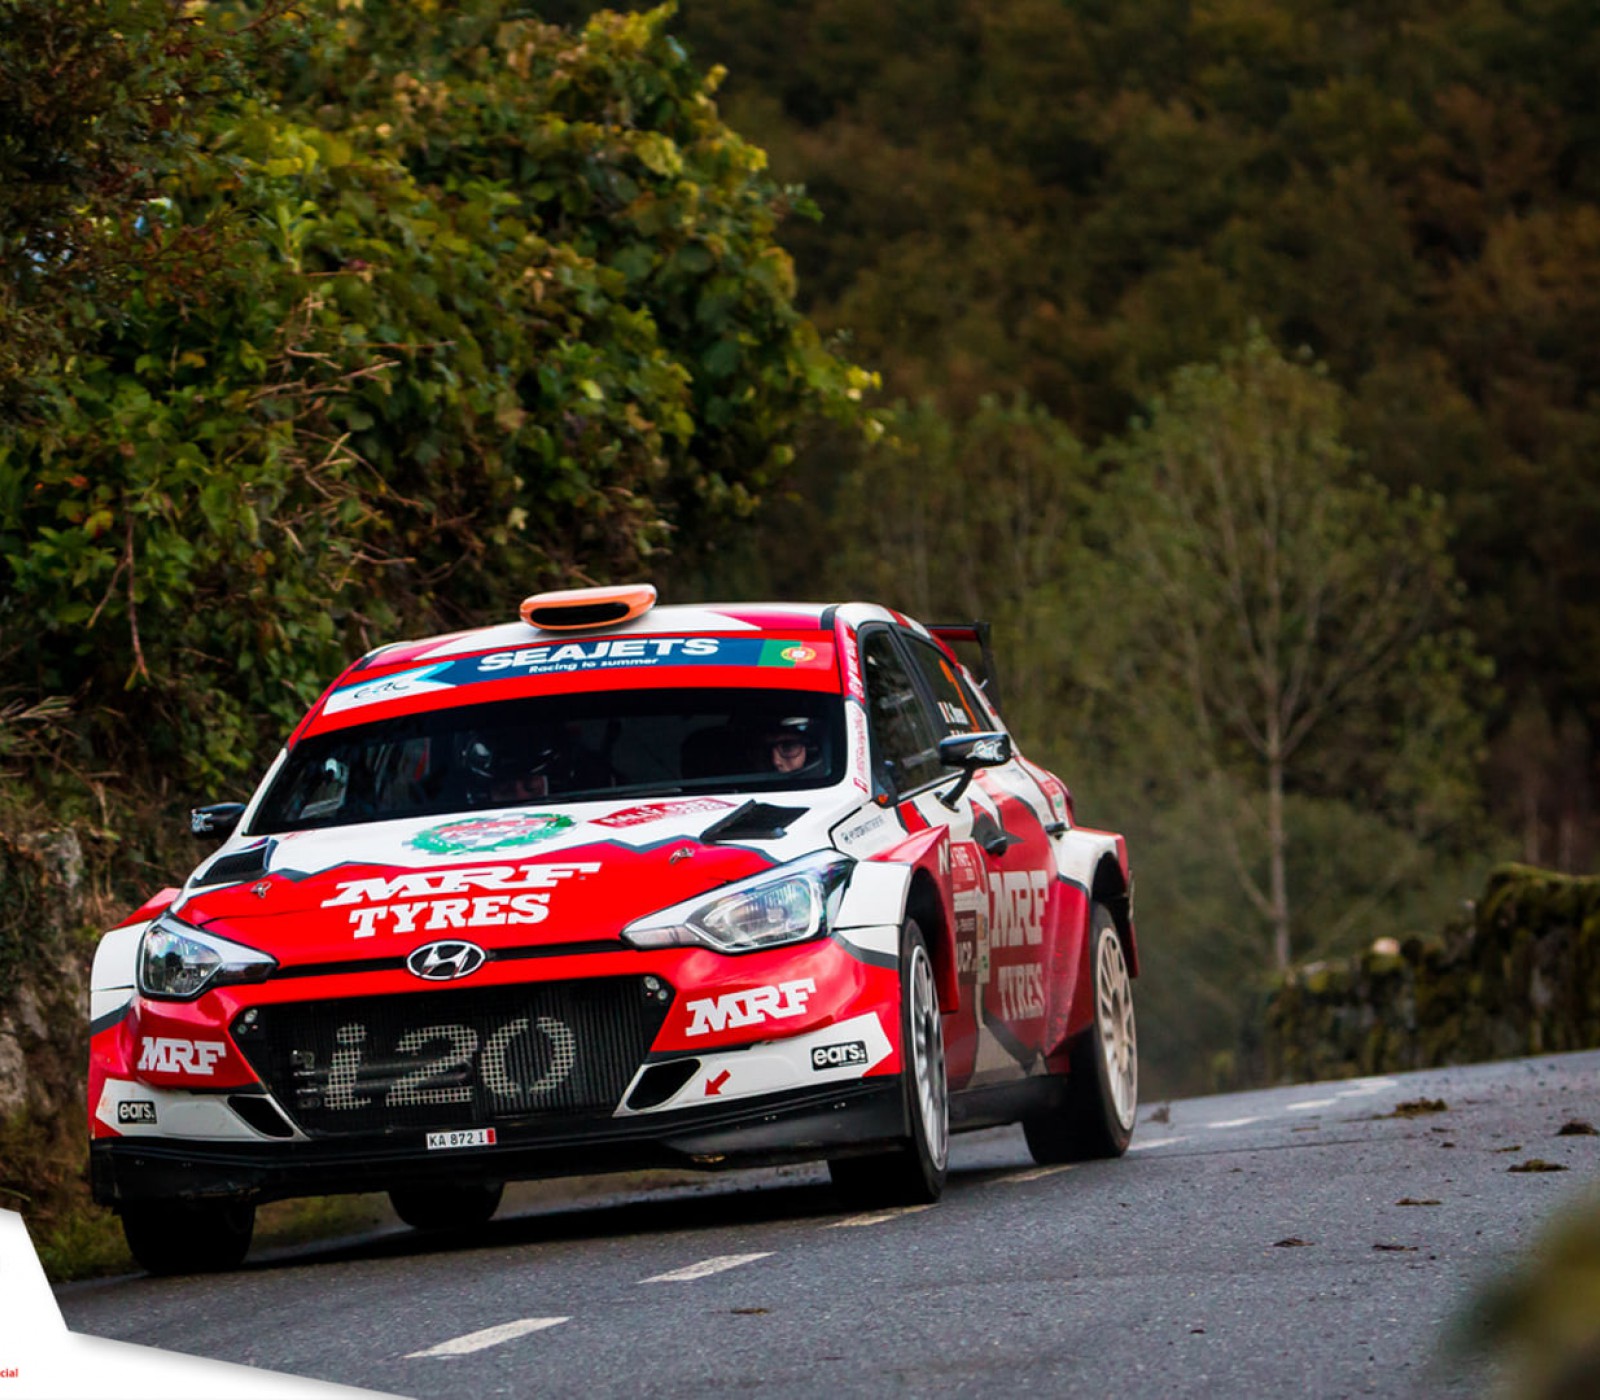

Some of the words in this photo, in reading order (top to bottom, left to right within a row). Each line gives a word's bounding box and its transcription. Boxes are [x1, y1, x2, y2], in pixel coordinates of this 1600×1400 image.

[477, 638, 720, 672] SEAJETS
[529, 661, 578, 673] Racing
[582, 659, 597, 668] to
[601, 657, 659, 667] summer
[320, 862, 602, 908] MRF
[349, 893, 551, 939] TYRES
[988, 870, 1049, 948] MRF
[684, 978, 816, 1037] MRF
[998, 962, 1045, 1021] TYRES
[137, 1037, 226, 1075] MRF
[324, 1017, 575, 1110] i20
[428, 1134, 446, 1147] KA
[450, 1132, 473, 1145] 872
